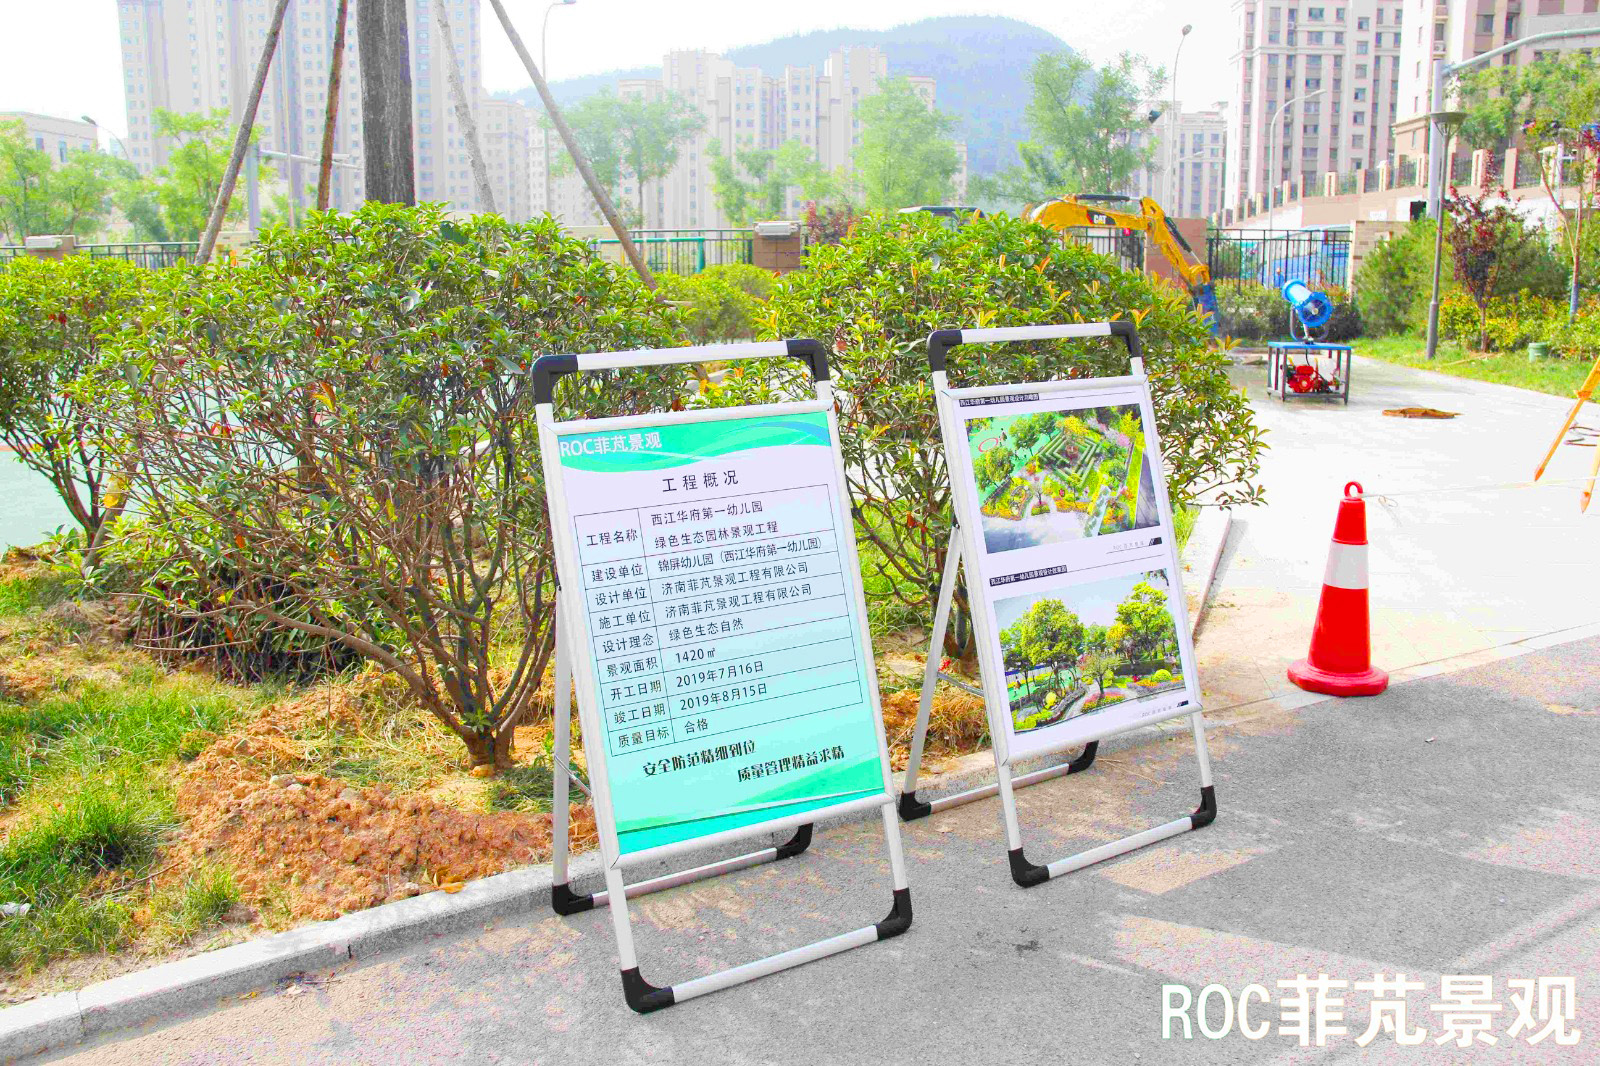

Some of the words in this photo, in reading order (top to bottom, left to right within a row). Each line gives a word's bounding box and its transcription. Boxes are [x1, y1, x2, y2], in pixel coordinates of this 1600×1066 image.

[1093, 215, 1107, 224] CAT
[560, 432, 662, 457] ROC菲芃景观
[662, 469, 739, 493] 工程概况
[651, 500, 763, 526] 西江华府第一幼儿园
[586, 528, 638, 547] 工程名称
[654, 520, 779, 549] 绿色生态园林景观工程
[591, 563, 644, 582] 建设单位
[661, 561, 808, 596] 济南菲芃景观工程有限公司
[595, 586, 648, 606] 设计单位
[665, 583, 812, 618] 济南菲芃景观工程有限公司
[598, 609, 651, 630] 施工单位
[669, 617, 744, 642] 绿色生态自然
[602, 633, 655, 654] 设计理念
[606, 656, 659, 677] 景观面积
[676, 661, 764, 688] 2019年7月16日
[610, 680, 662, 701] 开工日期
[680, 683, 767, 711] 2019年8月15日
[614, 702, 666, 725] 竣工日期
[618, 725, 670, 748] 质量目标
[684, 718, 709, 735] 合格
[642, 739, 756, 778] 安全防范精细到位
[737, 745, 845, 783] 质量管理精益求精
